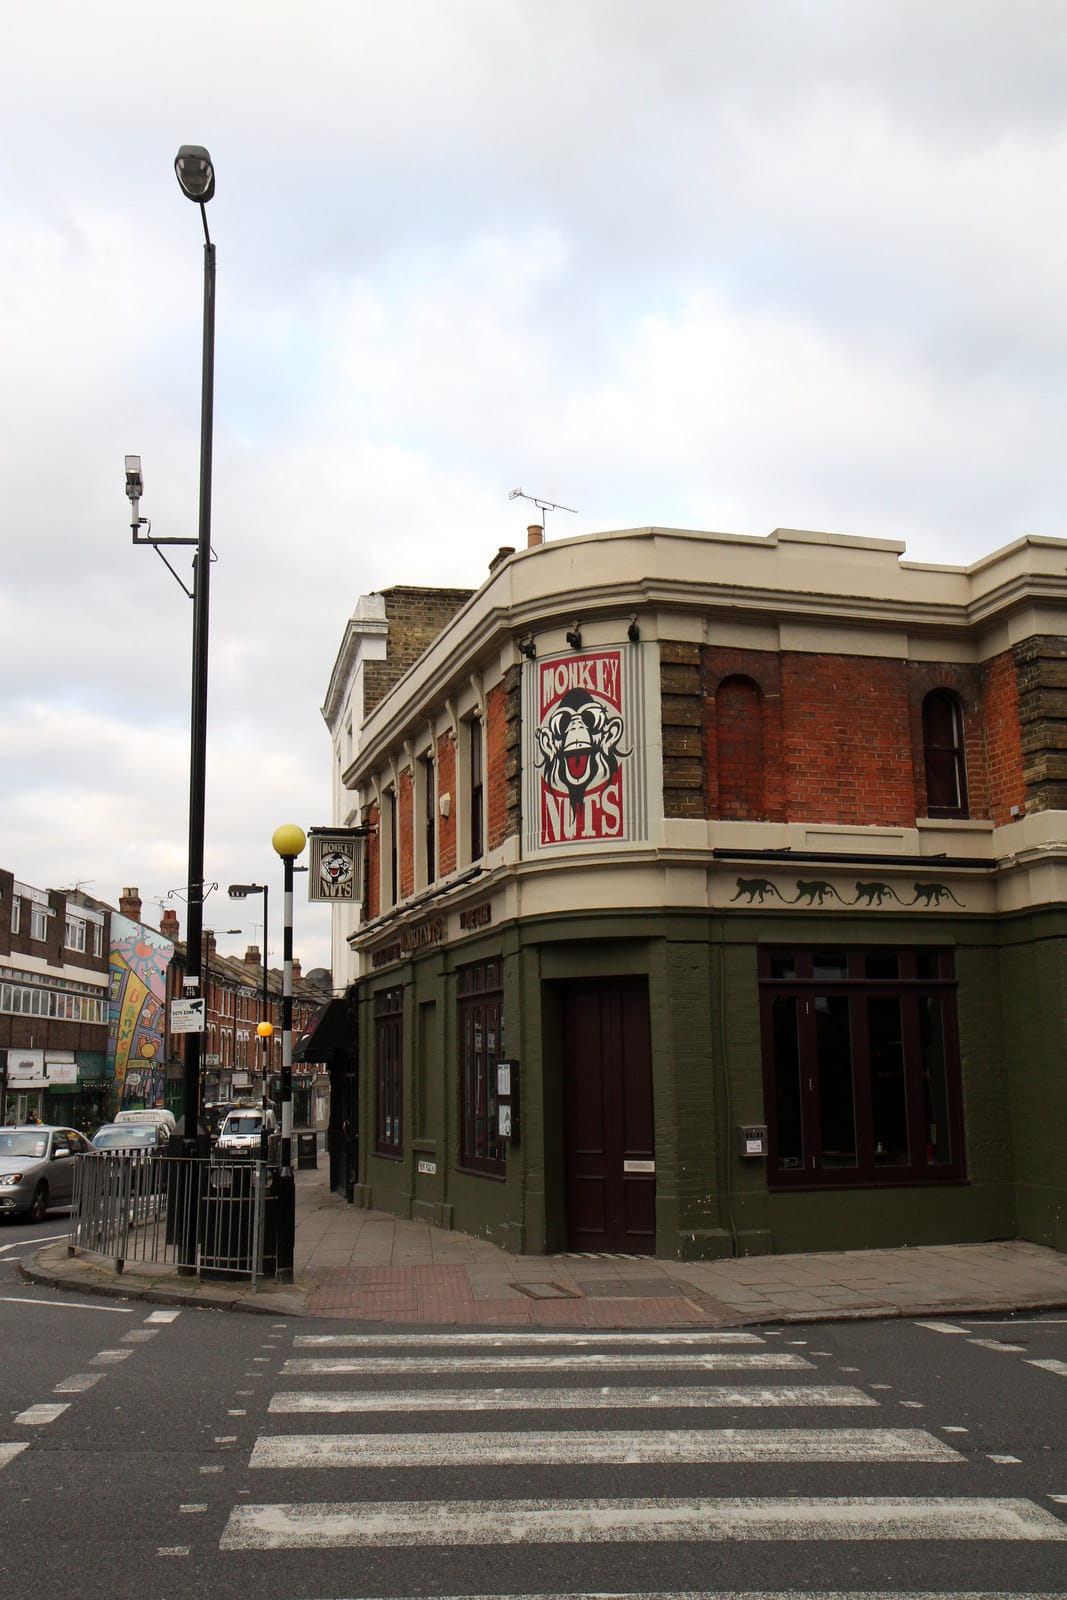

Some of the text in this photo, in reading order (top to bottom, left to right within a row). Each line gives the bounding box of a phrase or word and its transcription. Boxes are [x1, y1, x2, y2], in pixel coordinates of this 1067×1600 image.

[543, 659, 620, 707] MONKEY
[544, 782, 621, 842] NUTS
[322, 843, 353, 857] MONKEY
[321, 880, 352, 897] NUTS
